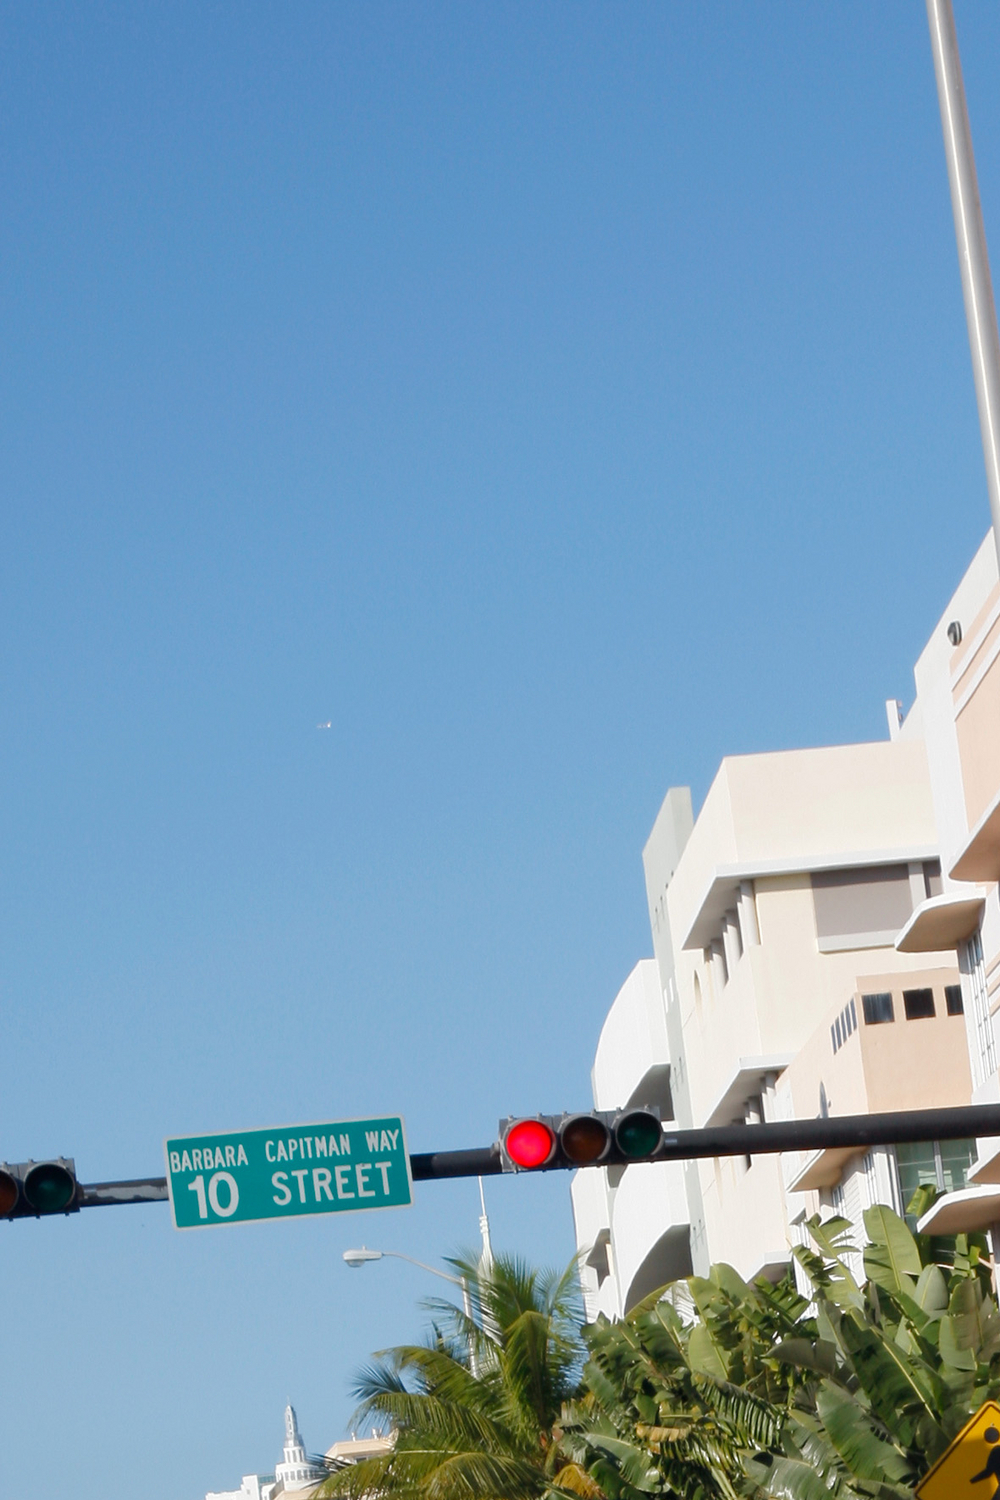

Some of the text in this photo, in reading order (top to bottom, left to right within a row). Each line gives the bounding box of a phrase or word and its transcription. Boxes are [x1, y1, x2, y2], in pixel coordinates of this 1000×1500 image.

[170, 1129, 399, 1173] BARBARA CAPITMAN WAY
[188, 1161, 392, 1219] 10 STREET
